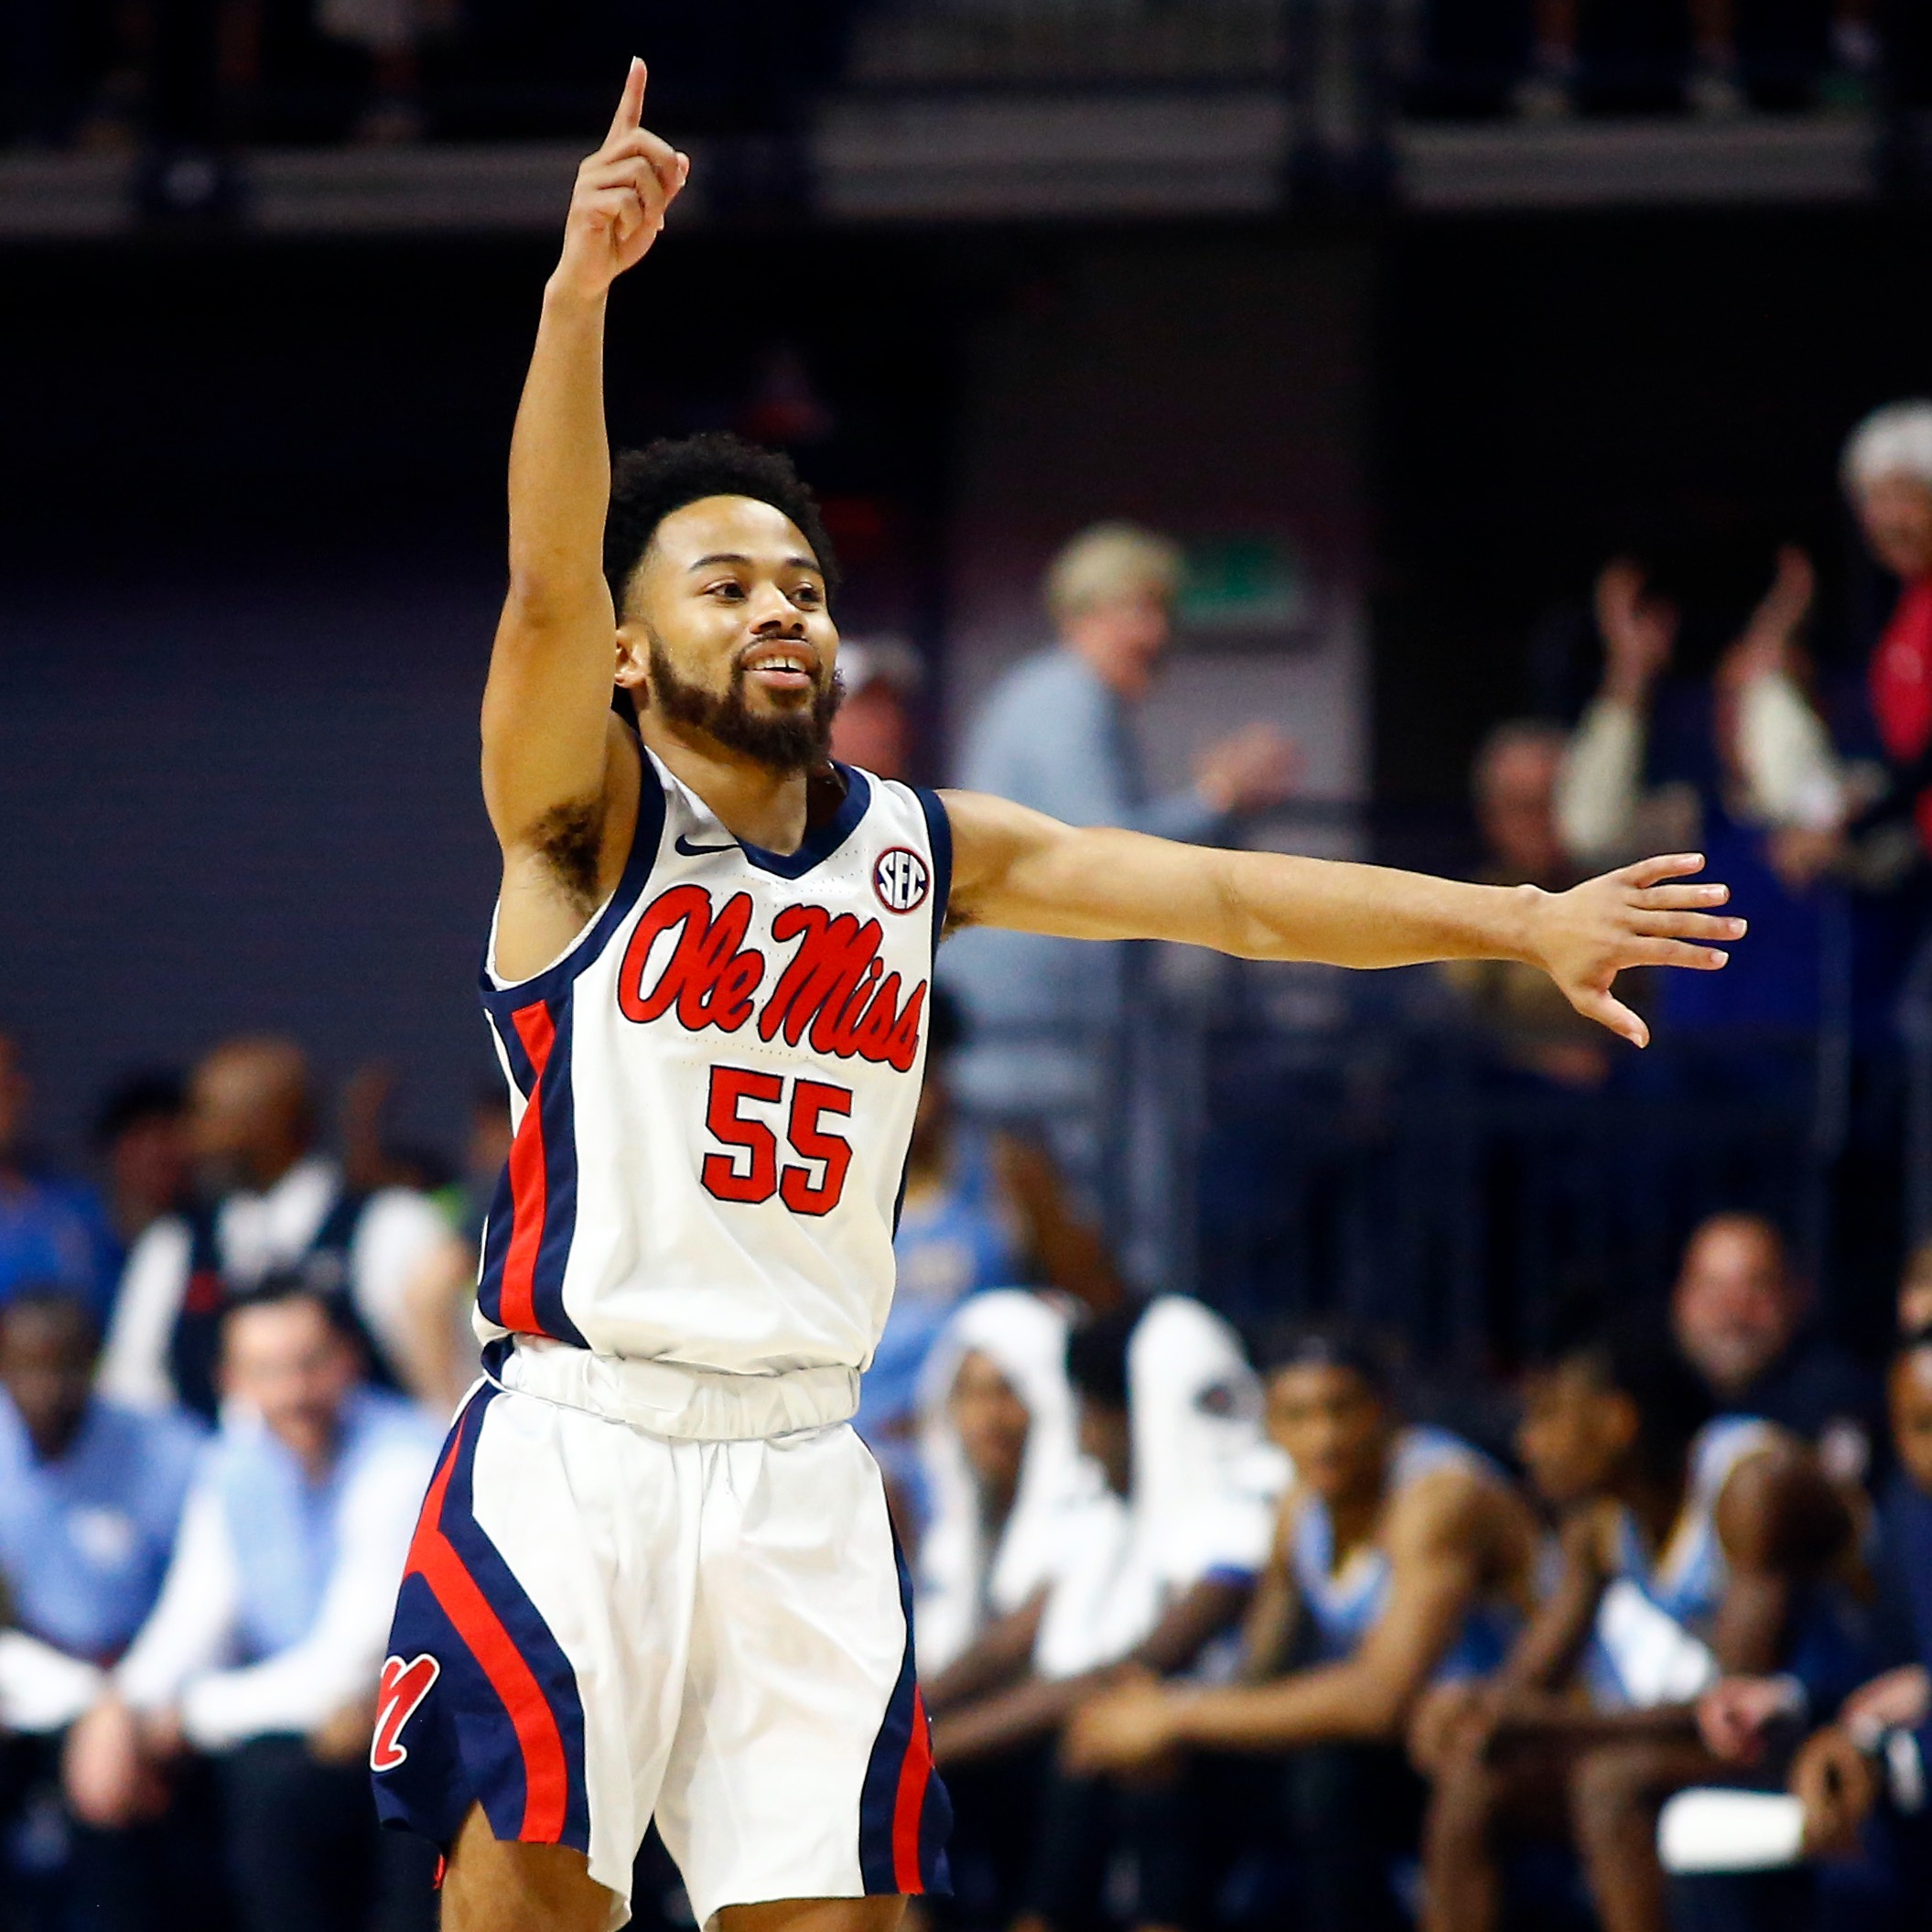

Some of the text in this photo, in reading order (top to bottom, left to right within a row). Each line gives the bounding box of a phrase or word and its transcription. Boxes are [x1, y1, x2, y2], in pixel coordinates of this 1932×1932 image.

[879, 852, 926, 910] SEC
[619, 884, 927, 1072] Ole Miss
[701, 1065, 853, 1216] 55
